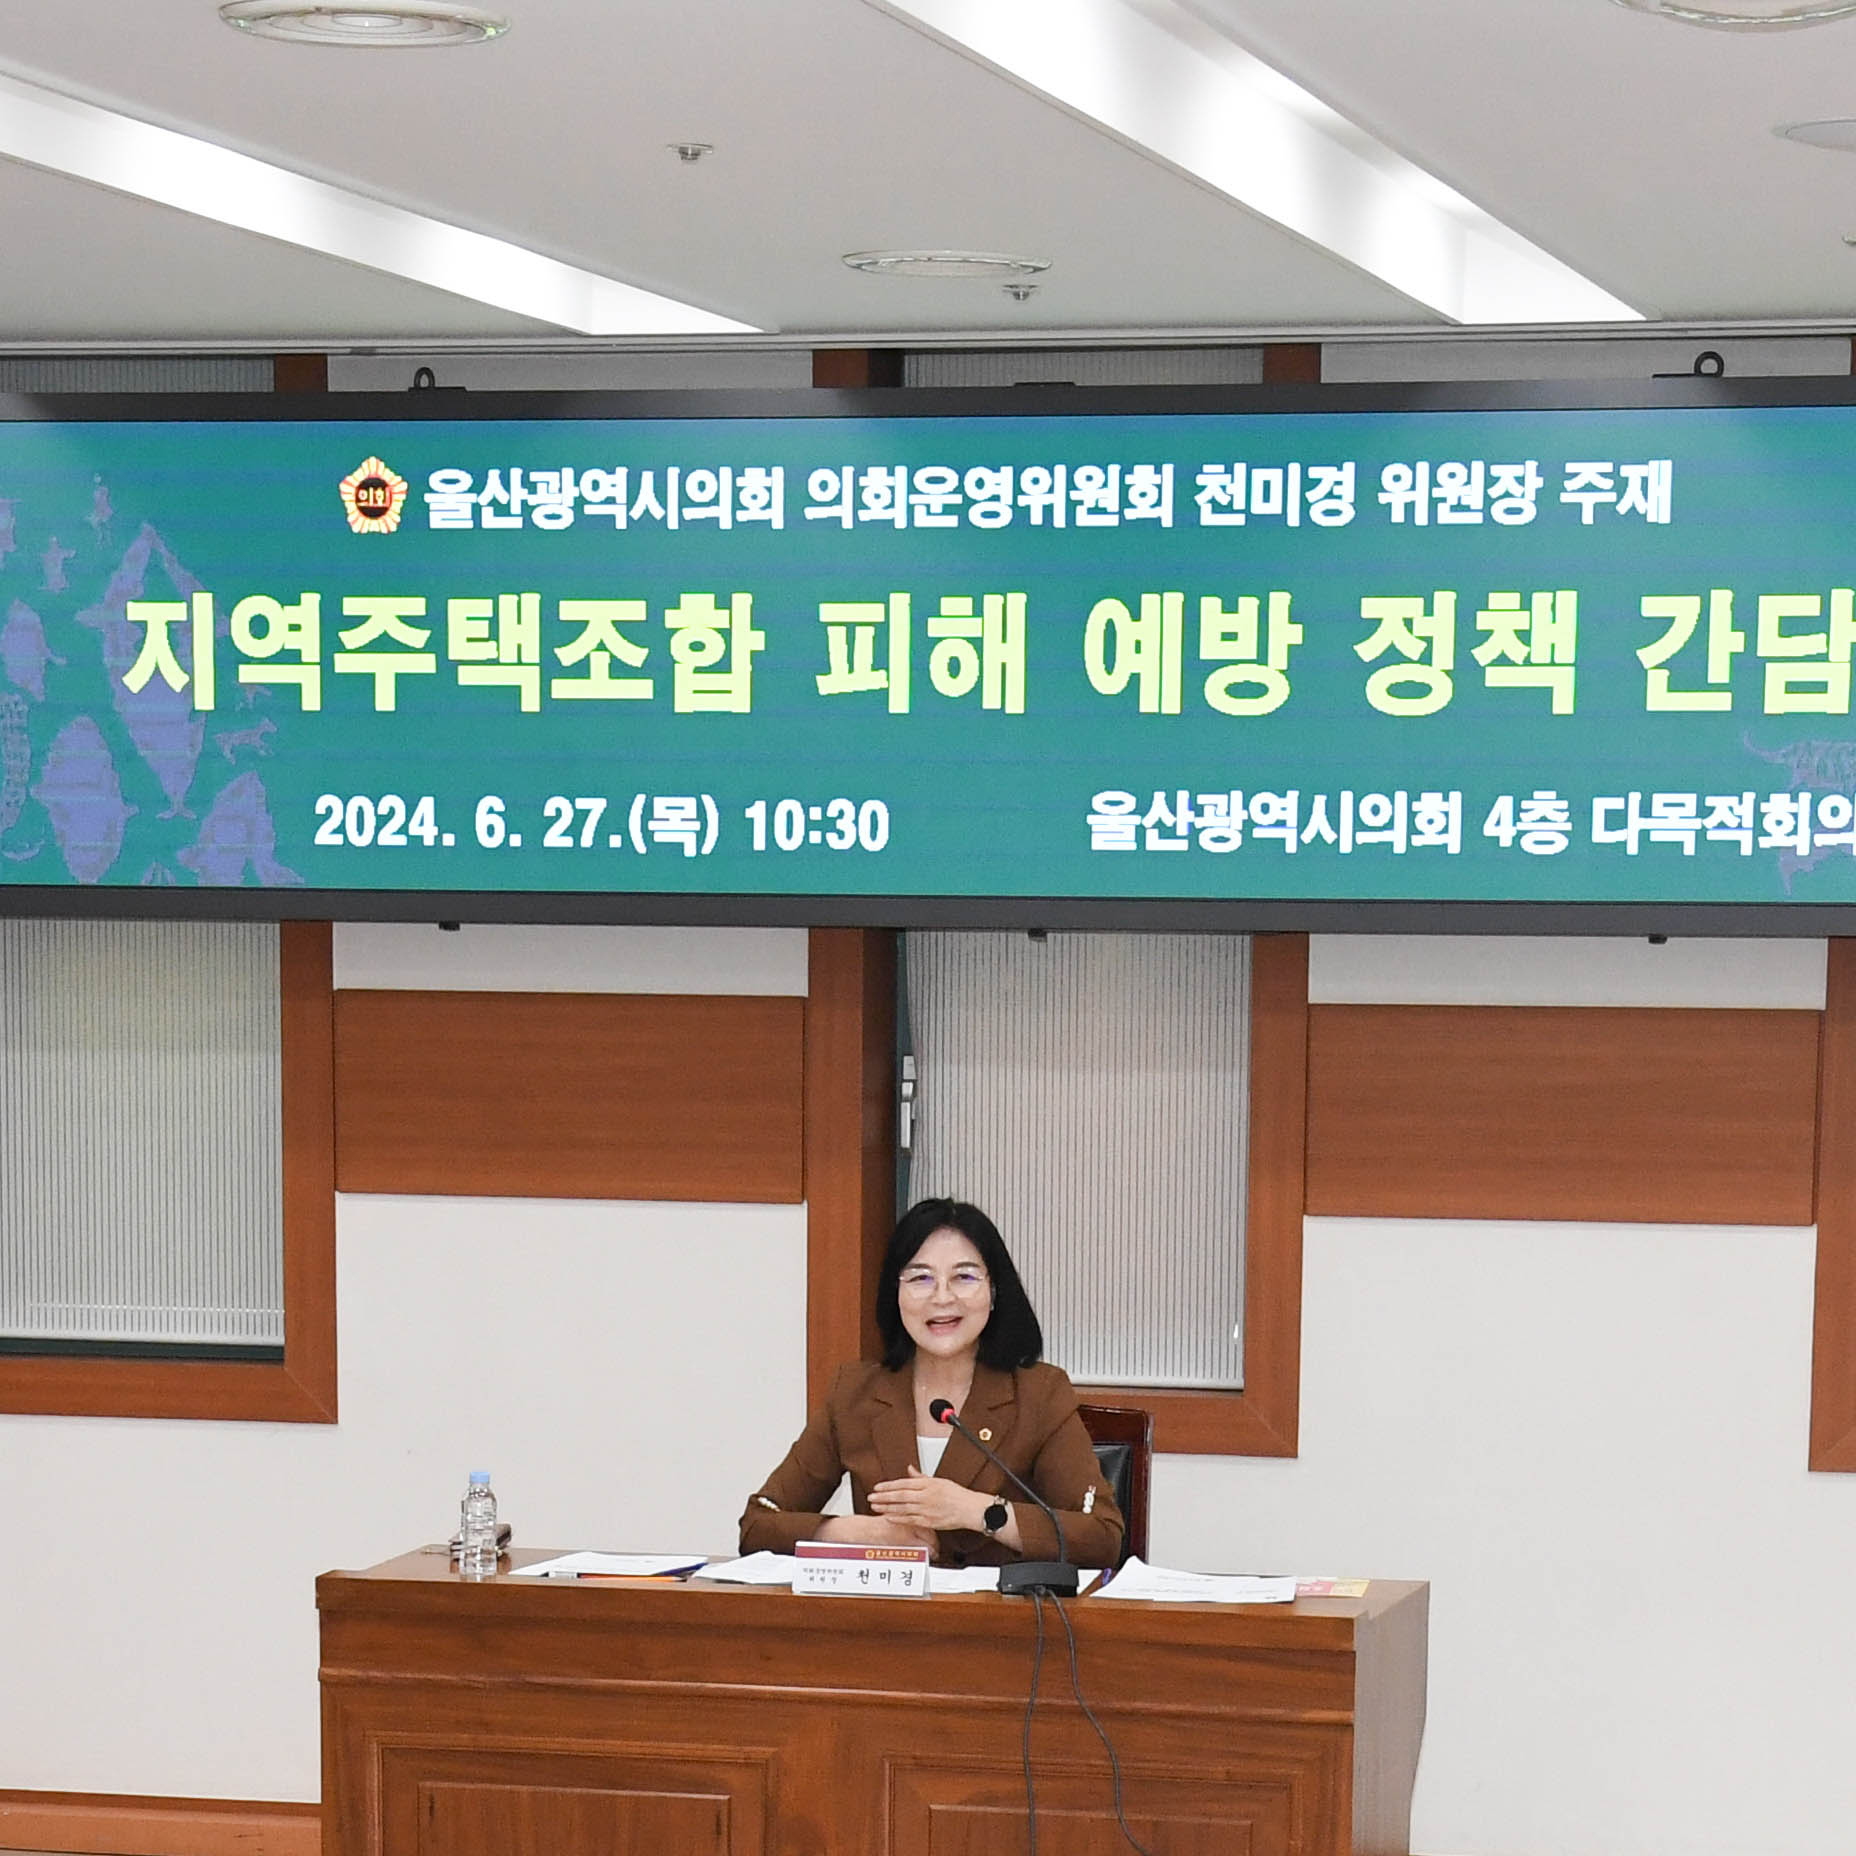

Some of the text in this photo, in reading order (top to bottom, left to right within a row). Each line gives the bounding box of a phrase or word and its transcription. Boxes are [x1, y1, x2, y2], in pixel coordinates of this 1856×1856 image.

[423, 460, 1673, 530] 울산광역시의회 의회운영위원회 천미경 위원장 주재
[122, 592, 766, 713] 지역주택조합
[815, 592, 1027, 714] 피해
[1084, 591, 1303, 716] 예방
[1353, 590, 1577, 716] 정책
[314, 794, 889, 857] 2024. 6. 27.(목) 10:30
[1087, 790, 1462, 855] 울산광역시의회
[1483, 791, 1572, 855] 4층
[858, 1567, 914, 1587] 천미경
